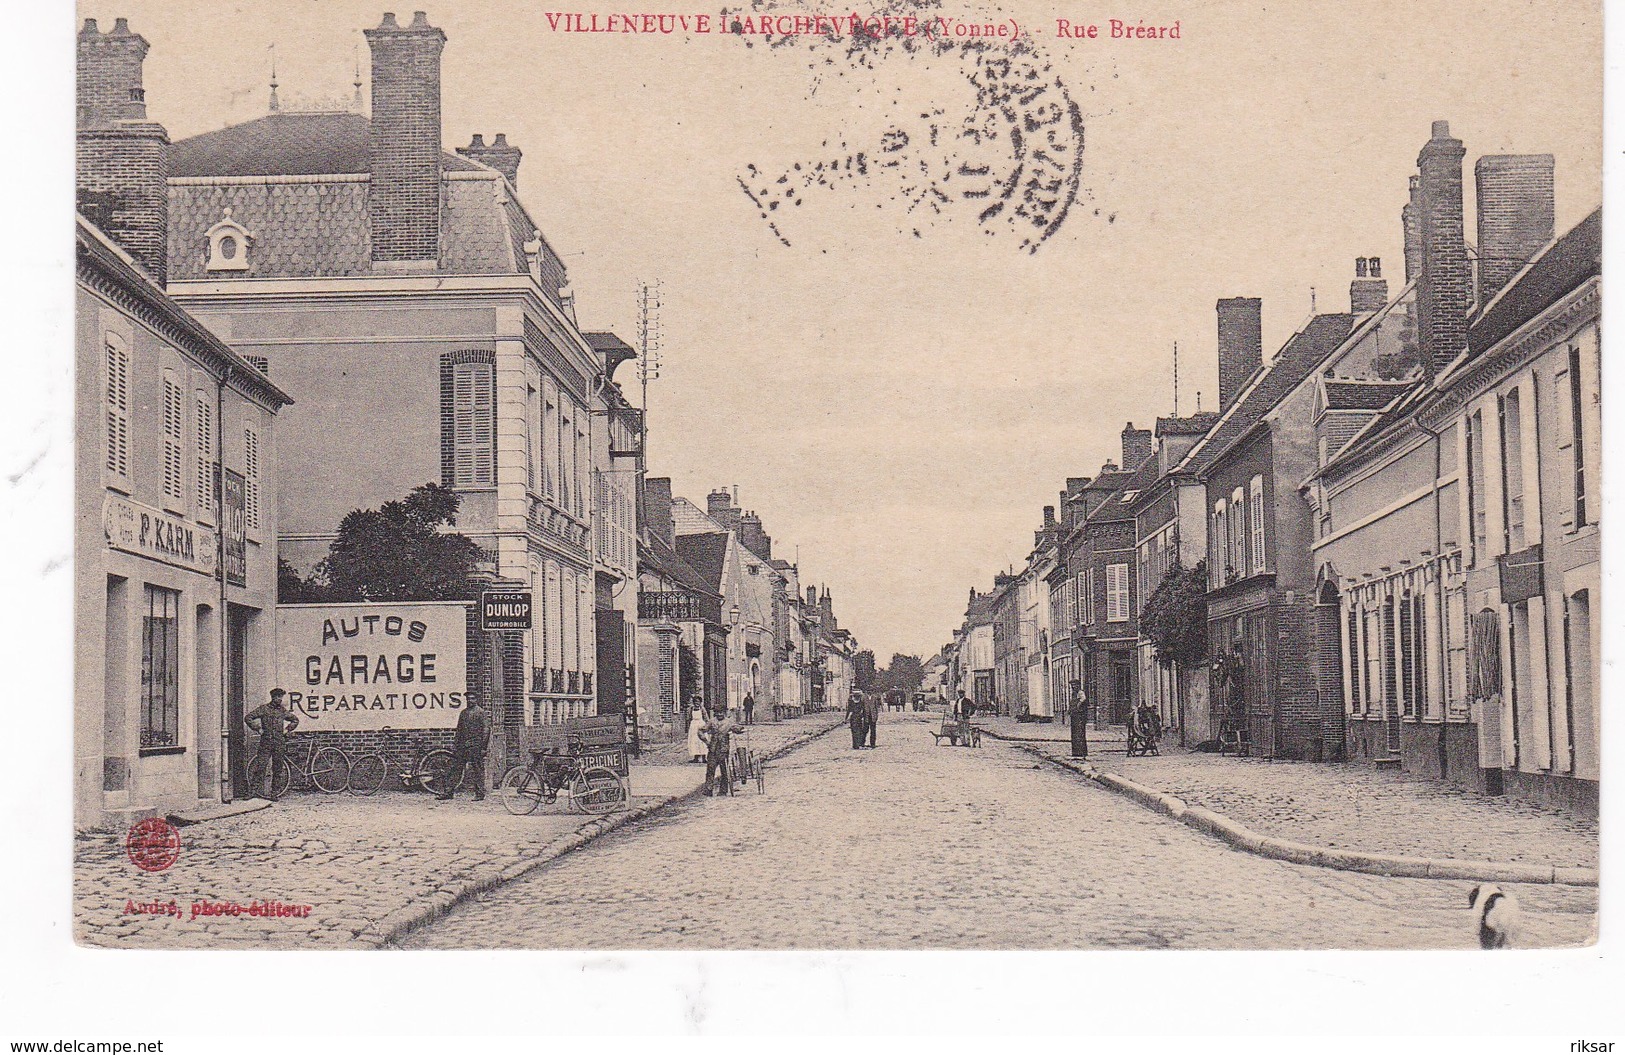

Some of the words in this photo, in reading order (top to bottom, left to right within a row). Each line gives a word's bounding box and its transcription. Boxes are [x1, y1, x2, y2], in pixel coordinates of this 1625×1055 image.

[486, 603, 529, 617] DUNLOP
[322, 615, 428, 646] AUTOS
[305, 654, 437, 685] GARAGE
[288, 690, 463, 719] RÉPARATIONS
